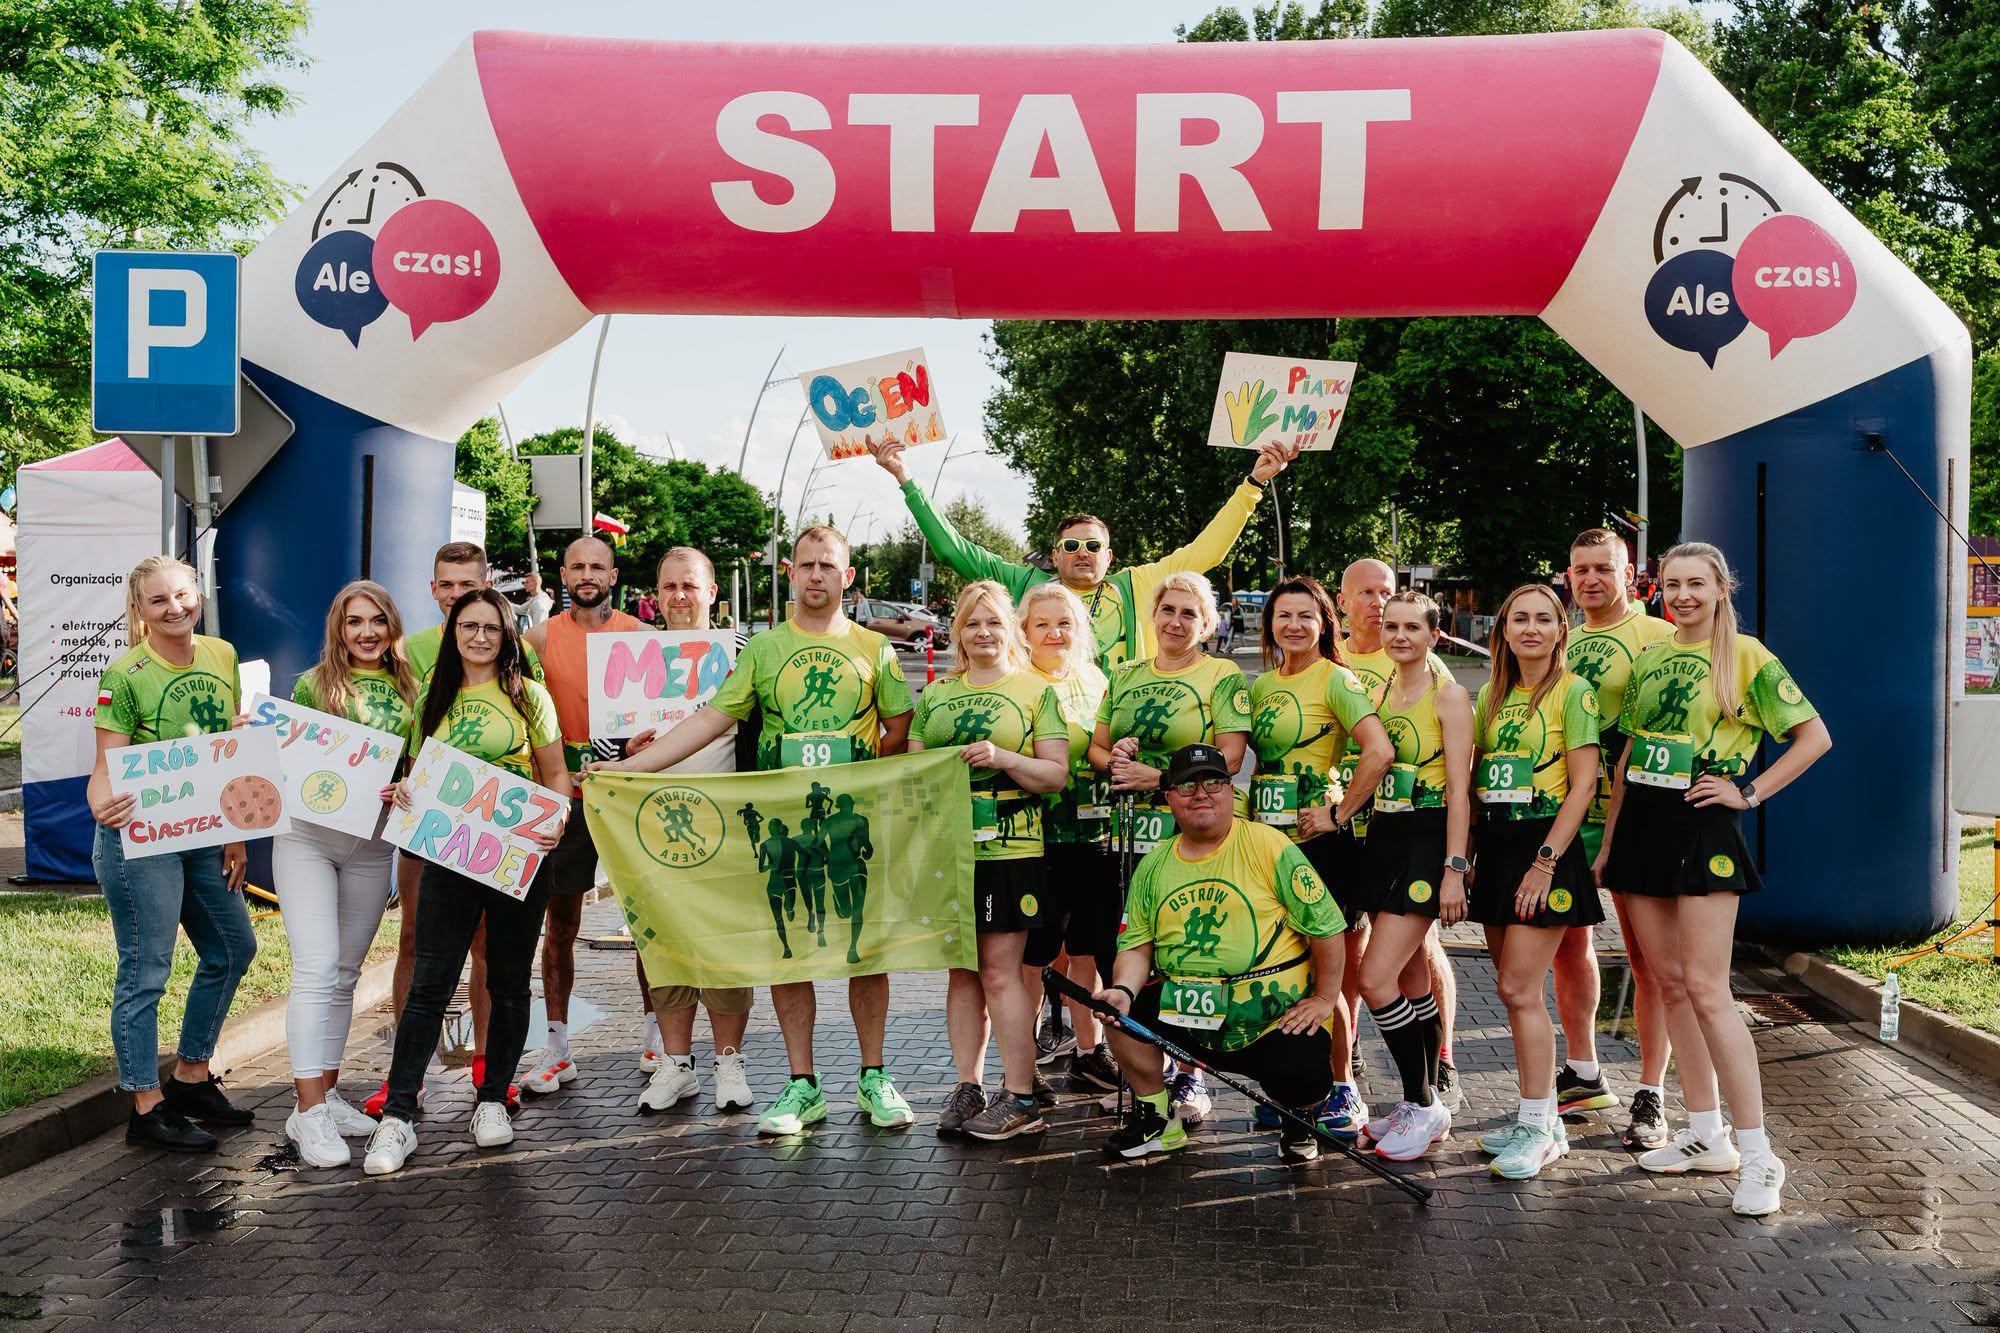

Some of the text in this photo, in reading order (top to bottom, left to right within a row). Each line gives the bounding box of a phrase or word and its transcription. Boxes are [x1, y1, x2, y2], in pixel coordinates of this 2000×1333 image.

[711, 88, 1412, 233] START
[313, 249, 482, 294] Ale czas!
[1666, 261, 1841, 316] Ale czas!
[128, 268, 208, 378] P
[1281, 405, 1342, 432] MOCY
[50, 573, 123, 588] Organizacja
[914, 582, 922, 592] P
[61, 636, 110, 649] medale,
[1567, 640, 1618, 660] OSTRÓW
[604, 638, 730, 699] META
[792, 652, 844, 668] OSTRÓW
[1654, 661, 1708, 682] OSTRÓW
[170, 677, 217, 702] OSTRÓW
[1133, 684, 1187, 701] OSTRÓW
[58, 707, 81, 717] +48
[947, 694, 1003, 712] OSTRÓW
[793, 714, 841, 729] BIEGA
[122, 738, 238, 780] ZRÓB TO
[802, 743, 831, 767] 89
[1645, 744, 1670, 771] 79
[1489, 763, 1513, 788] 93
[141, 781, 195, 809] DLA
[437, 761, 560, 840] DASZ
[1255, 786, 1285, 811] 105
[408, 809, 539, 896] RADĘ!
[1168, 884, 1229, 913] OSTRÓW
[1174, 989, 1216, 1015] 126
